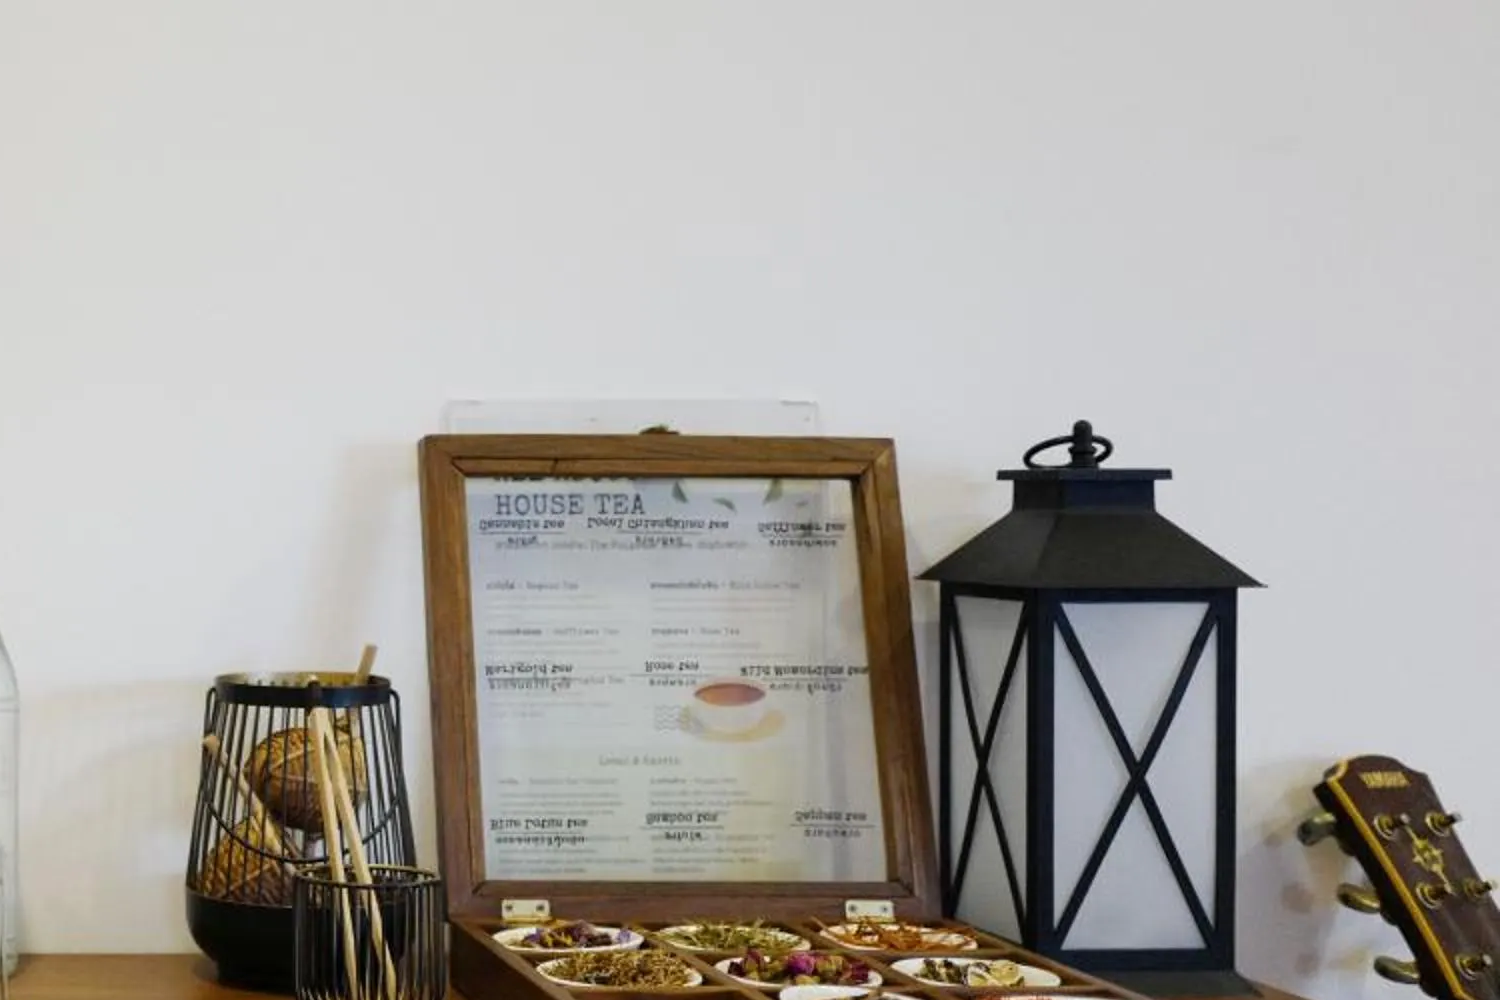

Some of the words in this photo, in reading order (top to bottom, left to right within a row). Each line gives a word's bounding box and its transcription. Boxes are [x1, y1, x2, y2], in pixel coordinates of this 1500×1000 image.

[495, 493, 584, 516] HOUSE
[593, 493, 646, 516] TEA
[1358, 771, 1410, 788] YAMAHA
